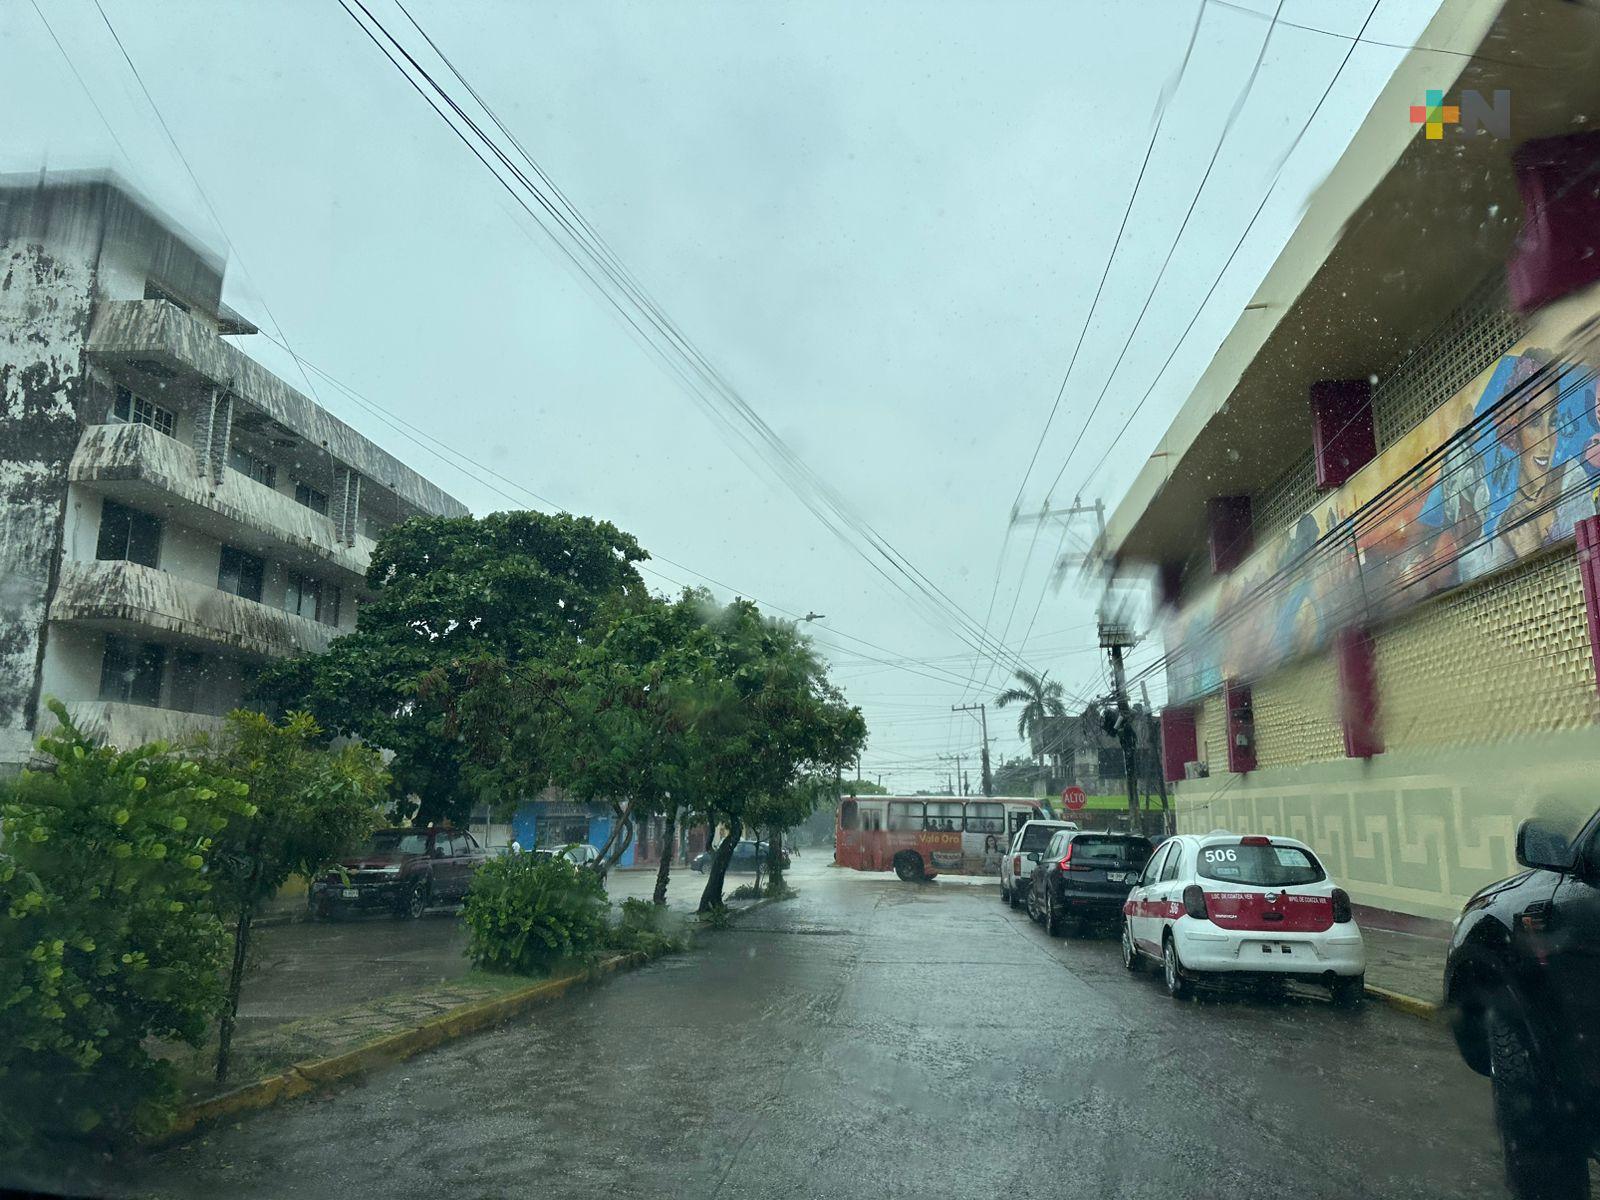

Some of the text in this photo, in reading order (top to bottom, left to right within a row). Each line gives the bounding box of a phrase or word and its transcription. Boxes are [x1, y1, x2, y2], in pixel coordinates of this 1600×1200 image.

[1064, 793, 1085, 803] ALTO
[919, 834, 940, 843] Vale
[941, 834, 960, 843] Oro
[1205, 849, 1237, 862] 506
